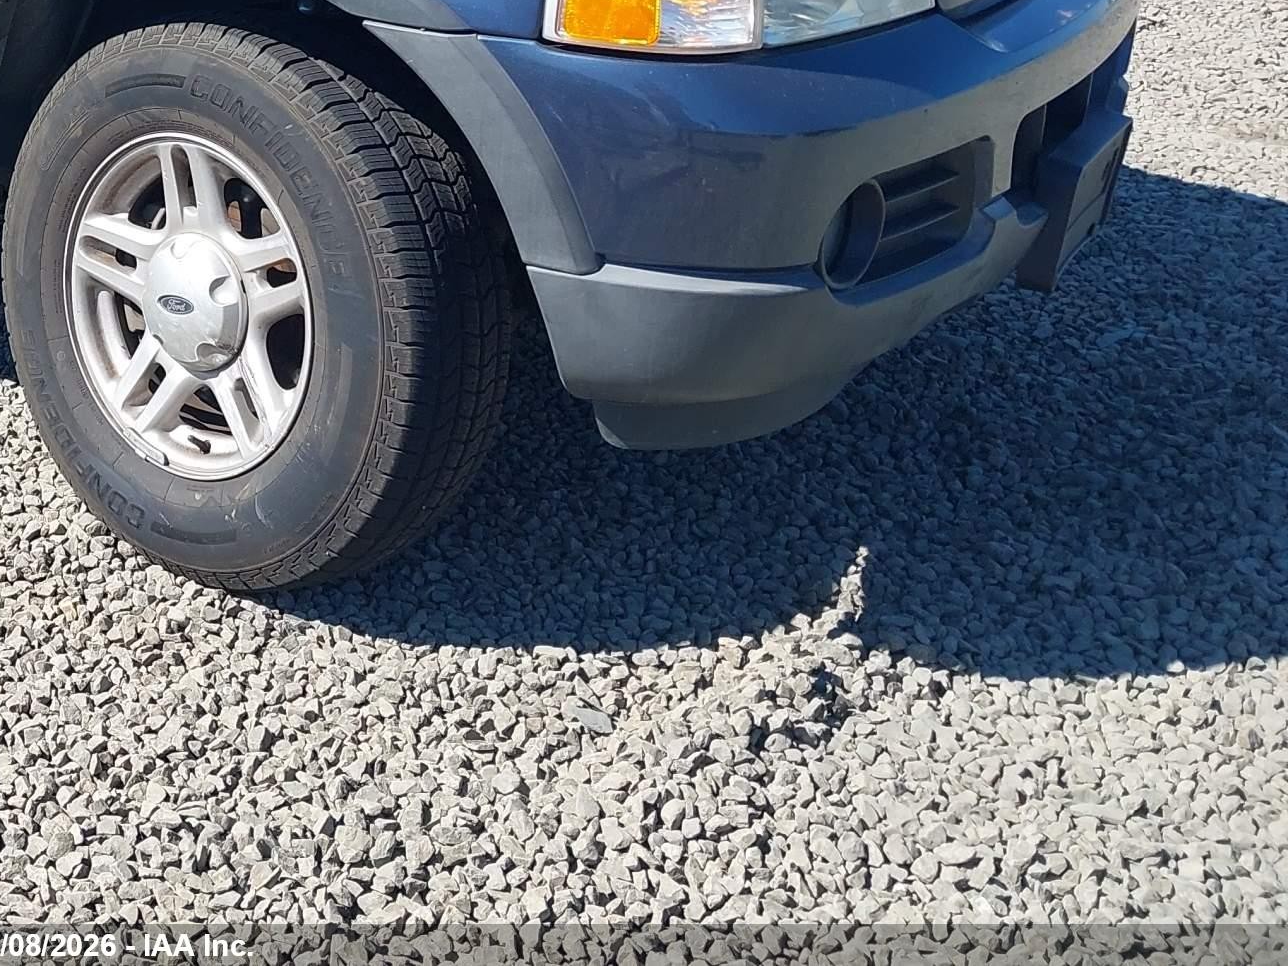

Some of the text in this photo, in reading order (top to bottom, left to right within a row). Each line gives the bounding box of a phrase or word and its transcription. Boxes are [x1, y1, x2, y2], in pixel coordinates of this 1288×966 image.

[189, 72, 352, 278] CONFIDENCE
[166, 298, 187, 312] Ford
[19, 329, 145, 529] CONFIDENCE
